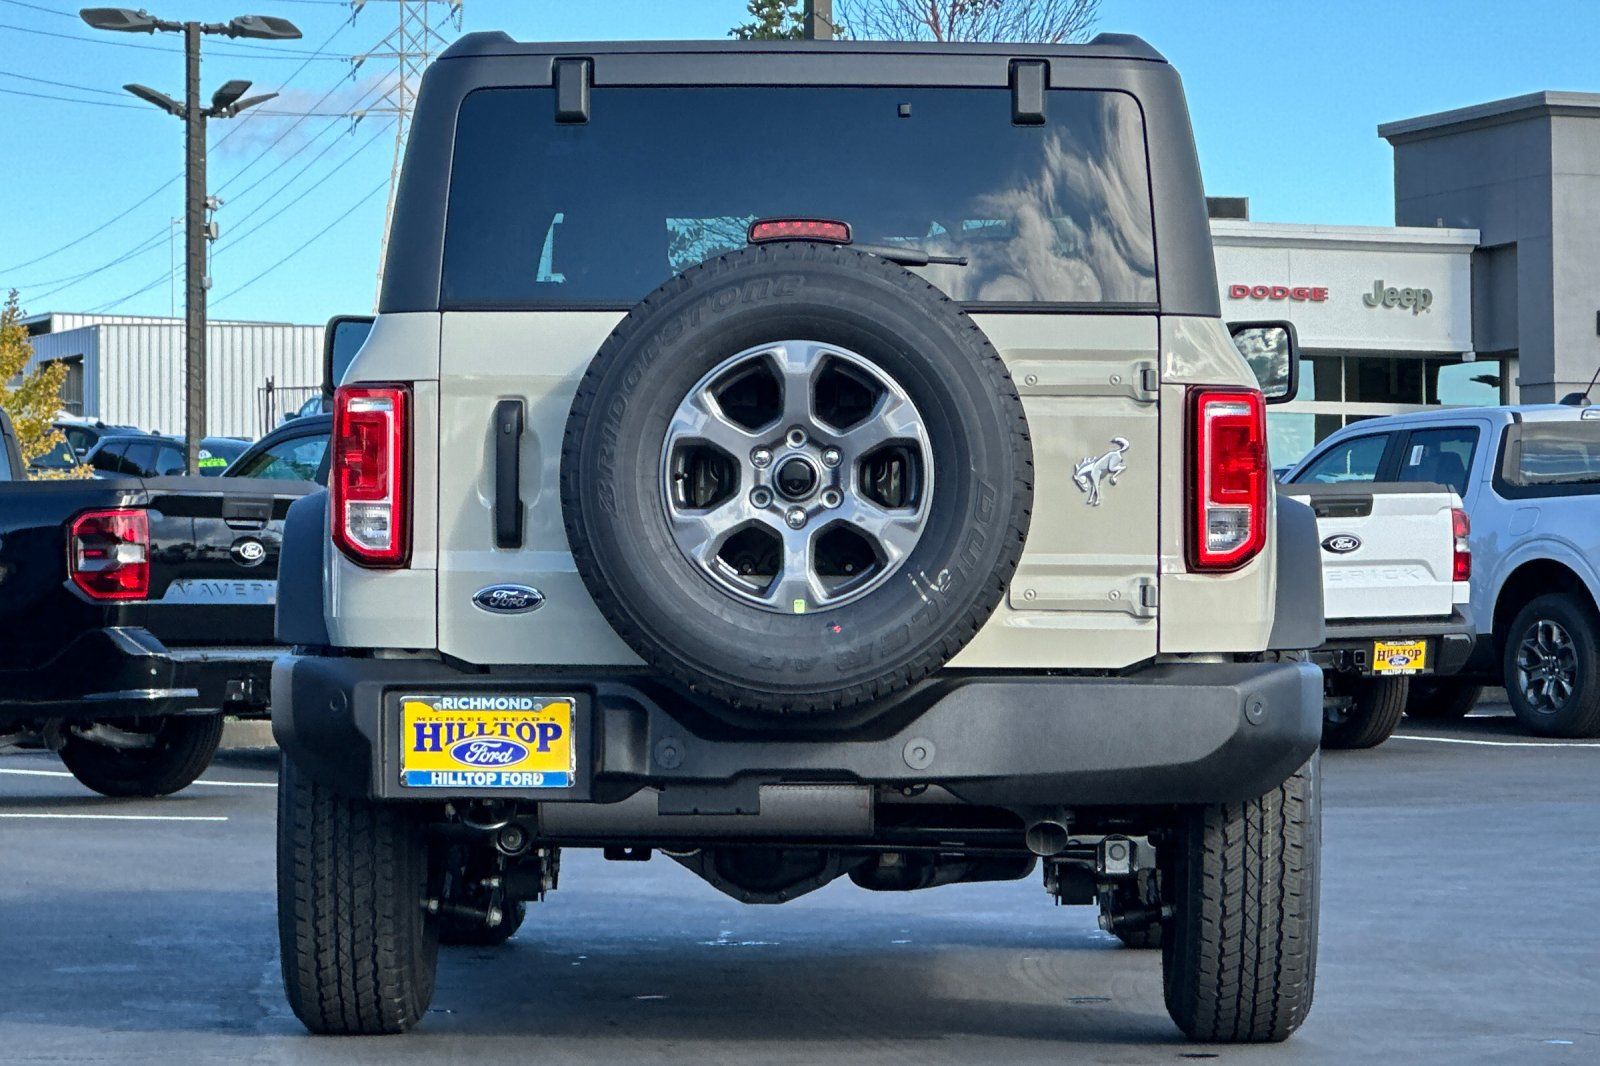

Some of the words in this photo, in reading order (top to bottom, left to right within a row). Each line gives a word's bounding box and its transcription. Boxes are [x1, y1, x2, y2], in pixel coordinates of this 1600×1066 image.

[1229, 284, 1329, 301] DODGE
[1362, 279, 1433, 315] Jeep
[489, 589, 528, 607] Ford
[1376, 649, 1422, 661] HILLTOP
[442, 697, 533, 711] RICHMOND
[413, 722, 563, 752] HILLTOP
[464, 741, 514, 763] Ford
[431, 772, 497, 786] HILLTOP
[501, 772, 544, 786] FORD
